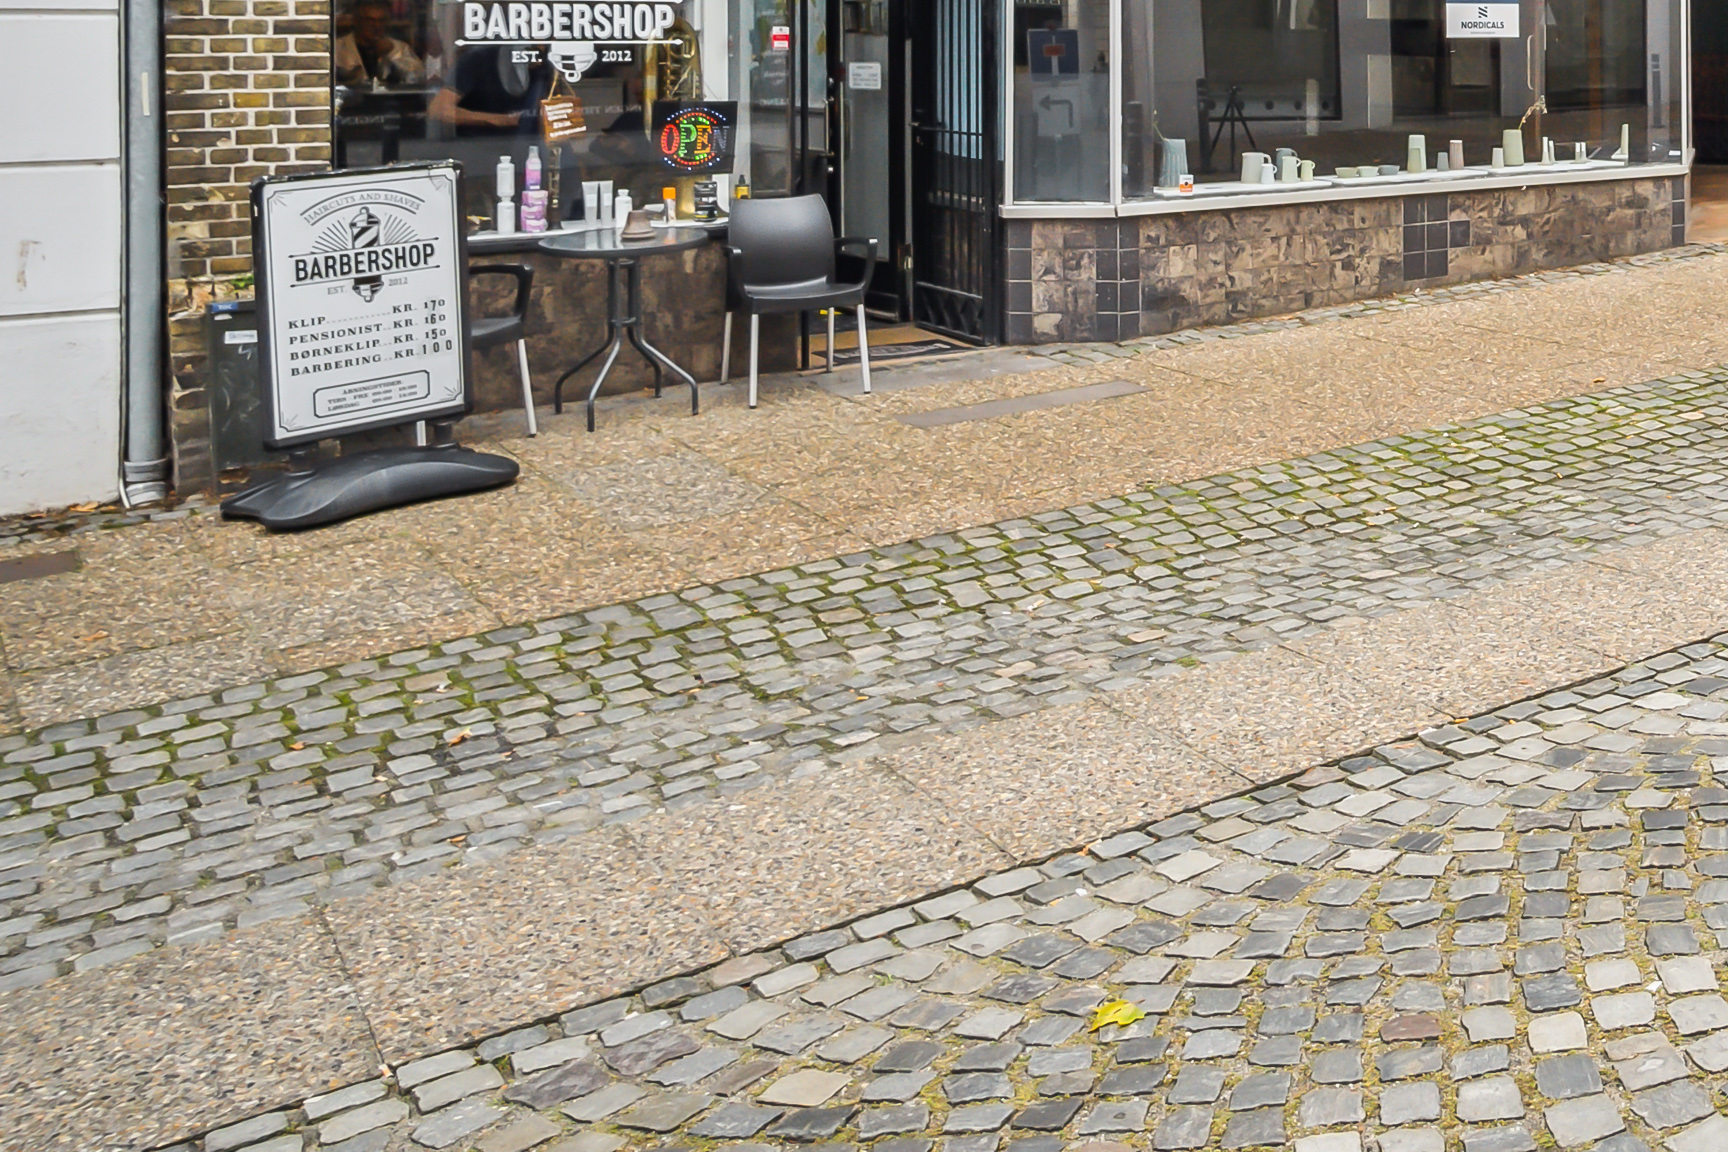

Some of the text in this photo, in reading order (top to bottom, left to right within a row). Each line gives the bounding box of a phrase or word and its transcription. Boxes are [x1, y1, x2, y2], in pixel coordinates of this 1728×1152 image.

[463, 2, 676, 40] BARBERSHOP
[1461, 21, 1505, 29] NORDICALS
[511, 50, 632, 63] EST. 2012
[660, 123, 730, 155] OPEN
[303, 192, 421, 224] HAIRCUTS AND SHAVES
[294, 243, 436, 282] BARBERSHOP
[327, 277, 408, 295] EST. 2012
[423, 299, 446, 311] 170
[424, 313, 446, 325] 160
[425, 328, 447, 340] 150
